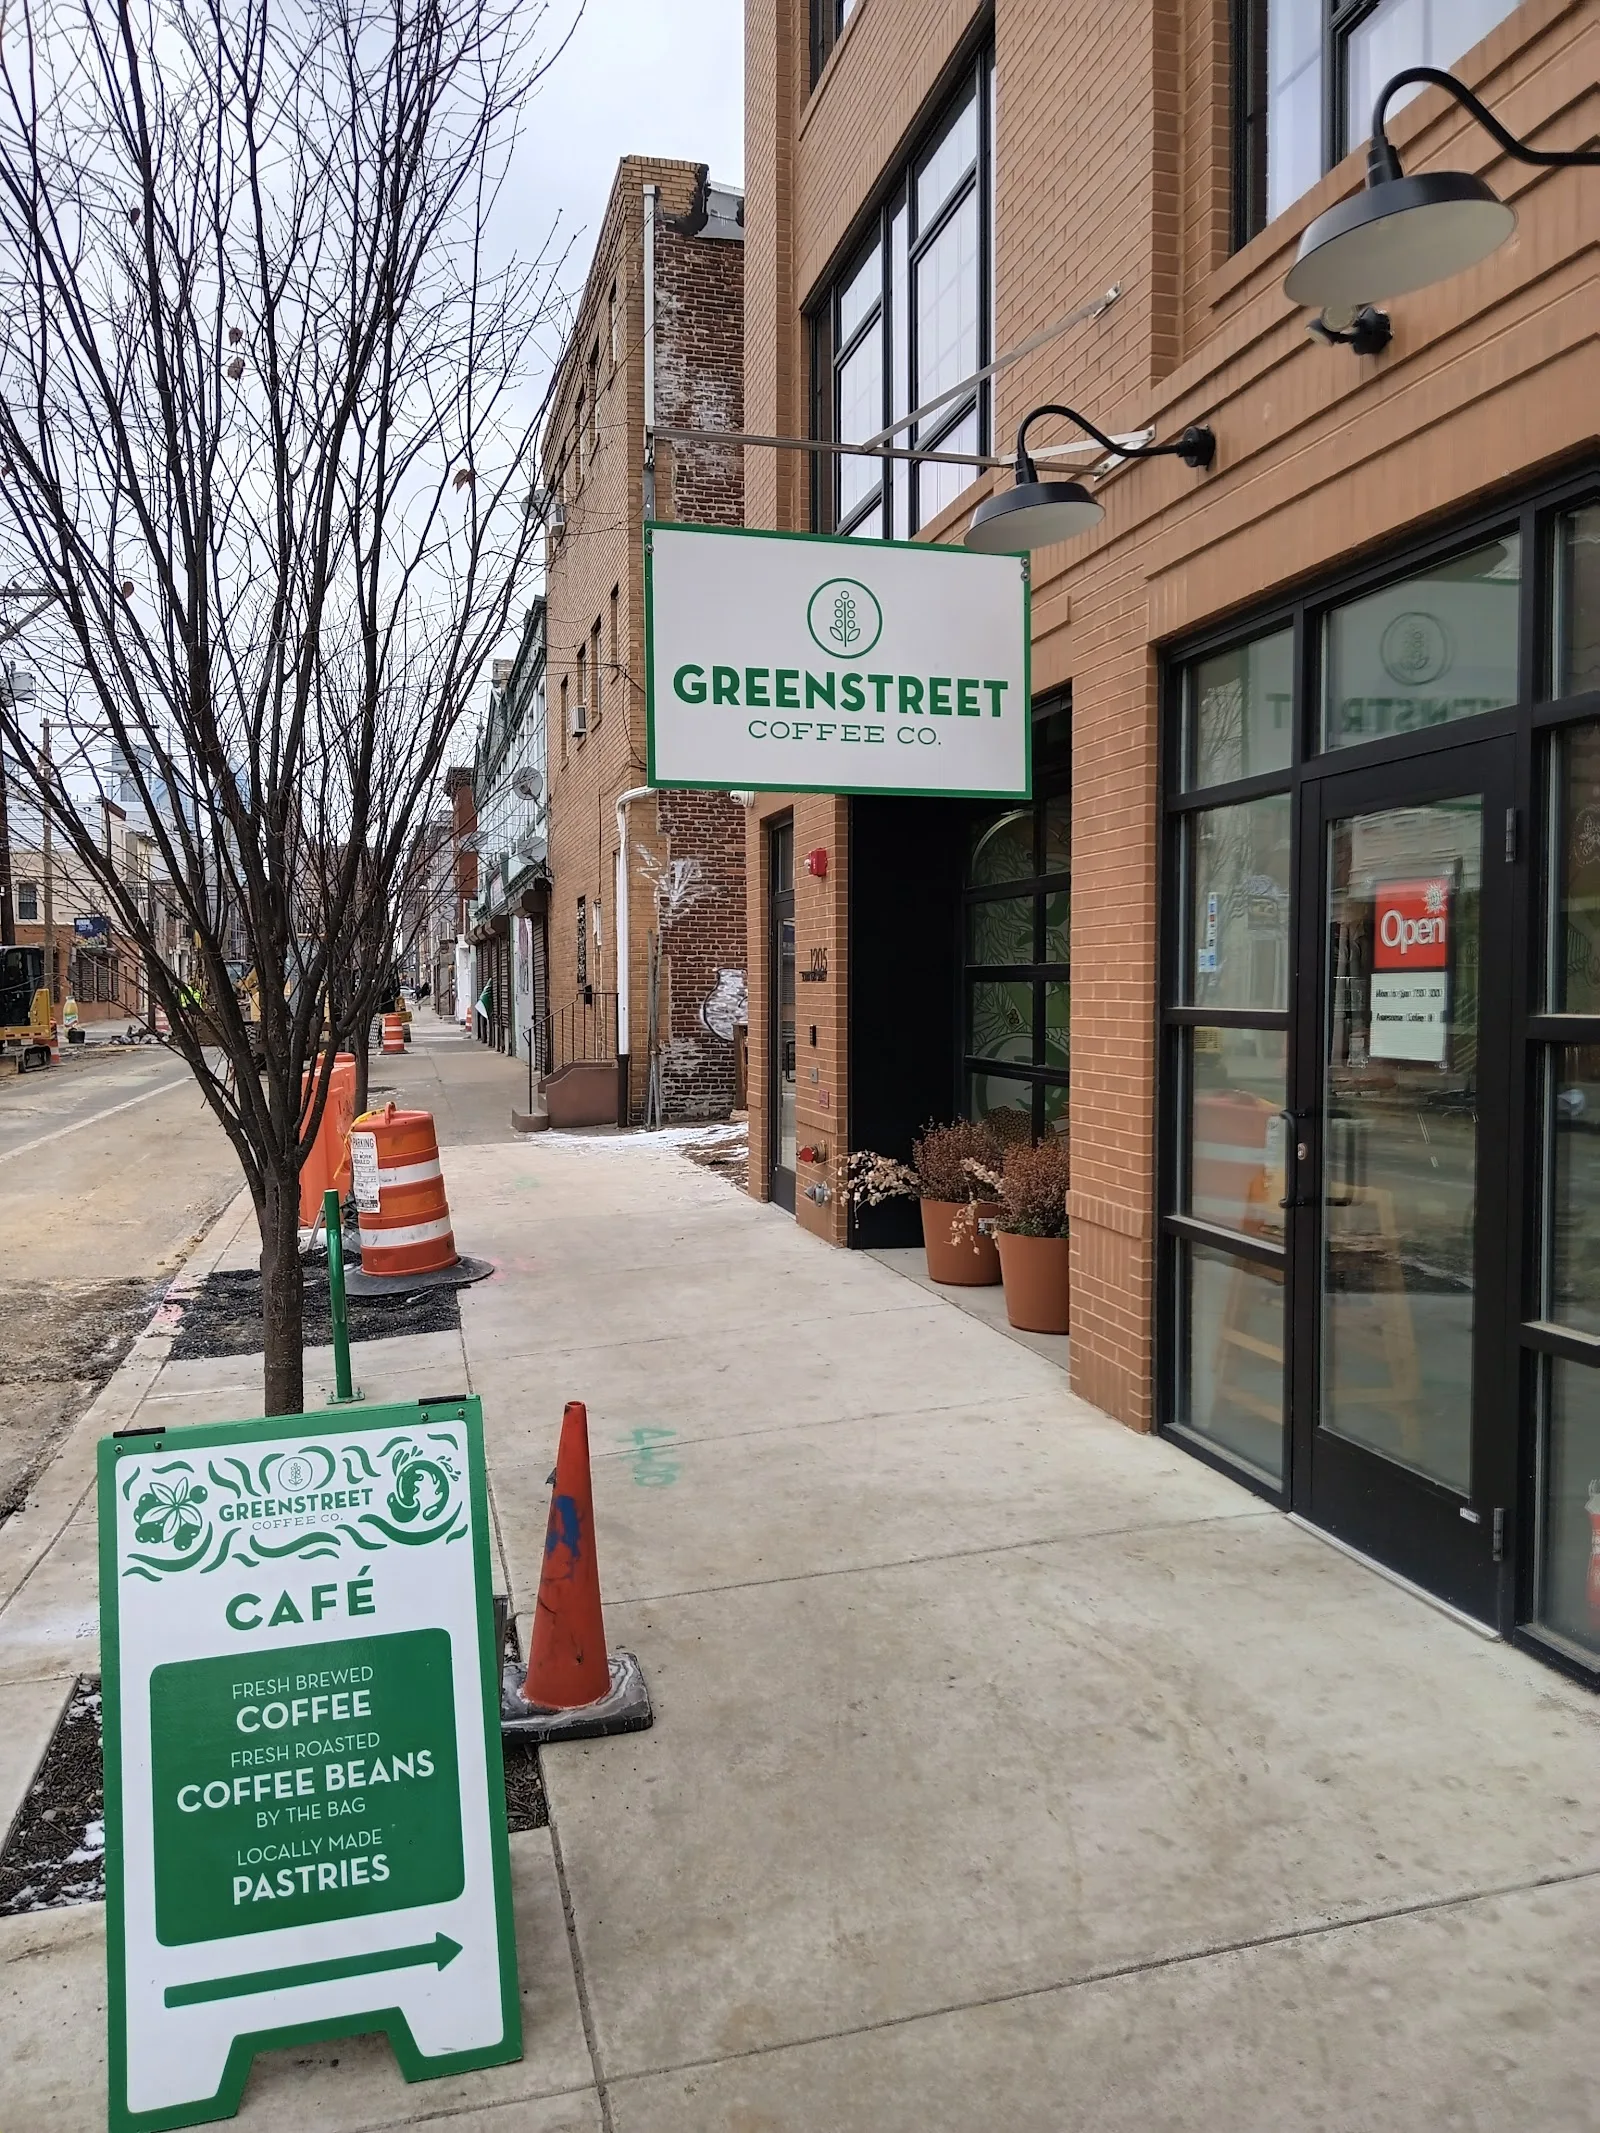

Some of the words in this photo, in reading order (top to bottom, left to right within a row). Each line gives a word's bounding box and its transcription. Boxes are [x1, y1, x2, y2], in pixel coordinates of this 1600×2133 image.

[673, 663, 1009, 718] GREENSTREET
[748, 719, 885, 744] COFFEE
[896, 726, 942, 746] CO.
[1380, 908, 1446, 955] Open
[810, 947, 828, 972] 1205
[218, 1487, 374, 1523] GREENSTREET
[251, 1514, 317, 1532] COFFEE
[320, 1512, 345, 1524] CO.
[225, 1564, 376, 1631] CAFÉ
[232, 1676, 290, 1700] FRESH
[296, 1665, 374, 1691] BREWED
[236, 1689, 372, 1733] COFFEE
[231, 1744, 289, 1768] FRESH
[295, 1732, 380, 1759] ROASTED
[176, 1766, 315, 1813] COFFEE
[325, 1750, 435, 1792] BEANS
[256, 1809, 280, 1829] BY
[285, 1803, 322, 1823] THE
[327, 1796, 366, 1817] BAG
[237, 1837, 323, 1866] LOCALLY
[328, 1828, 383, 1852] MADE
[232, 1853, 391, 1906] PASTRIES
